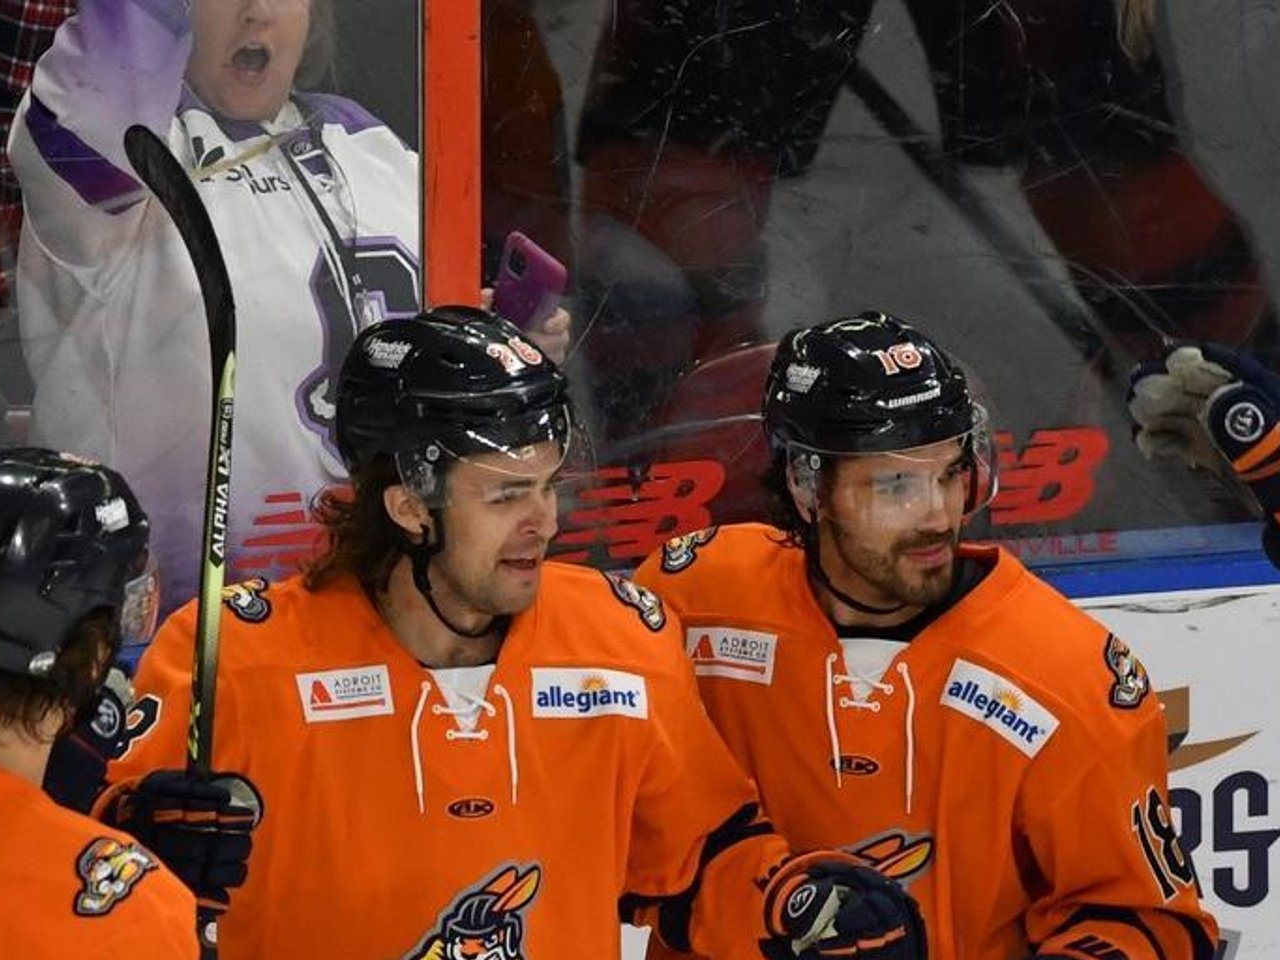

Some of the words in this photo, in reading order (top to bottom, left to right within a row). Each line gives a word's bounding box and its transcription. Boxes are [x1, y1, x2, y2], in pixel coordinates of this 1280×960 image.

[212, 482, 229, 558] ALPHA
[720, 636, 770, 650] ADROIT
[334, 674, 381, 688] ADROIT
[537, 685, 638, 713] allegiant
[948, 681, 1040, 743] allegiant
[1131, 785, 1194, 901] 18
